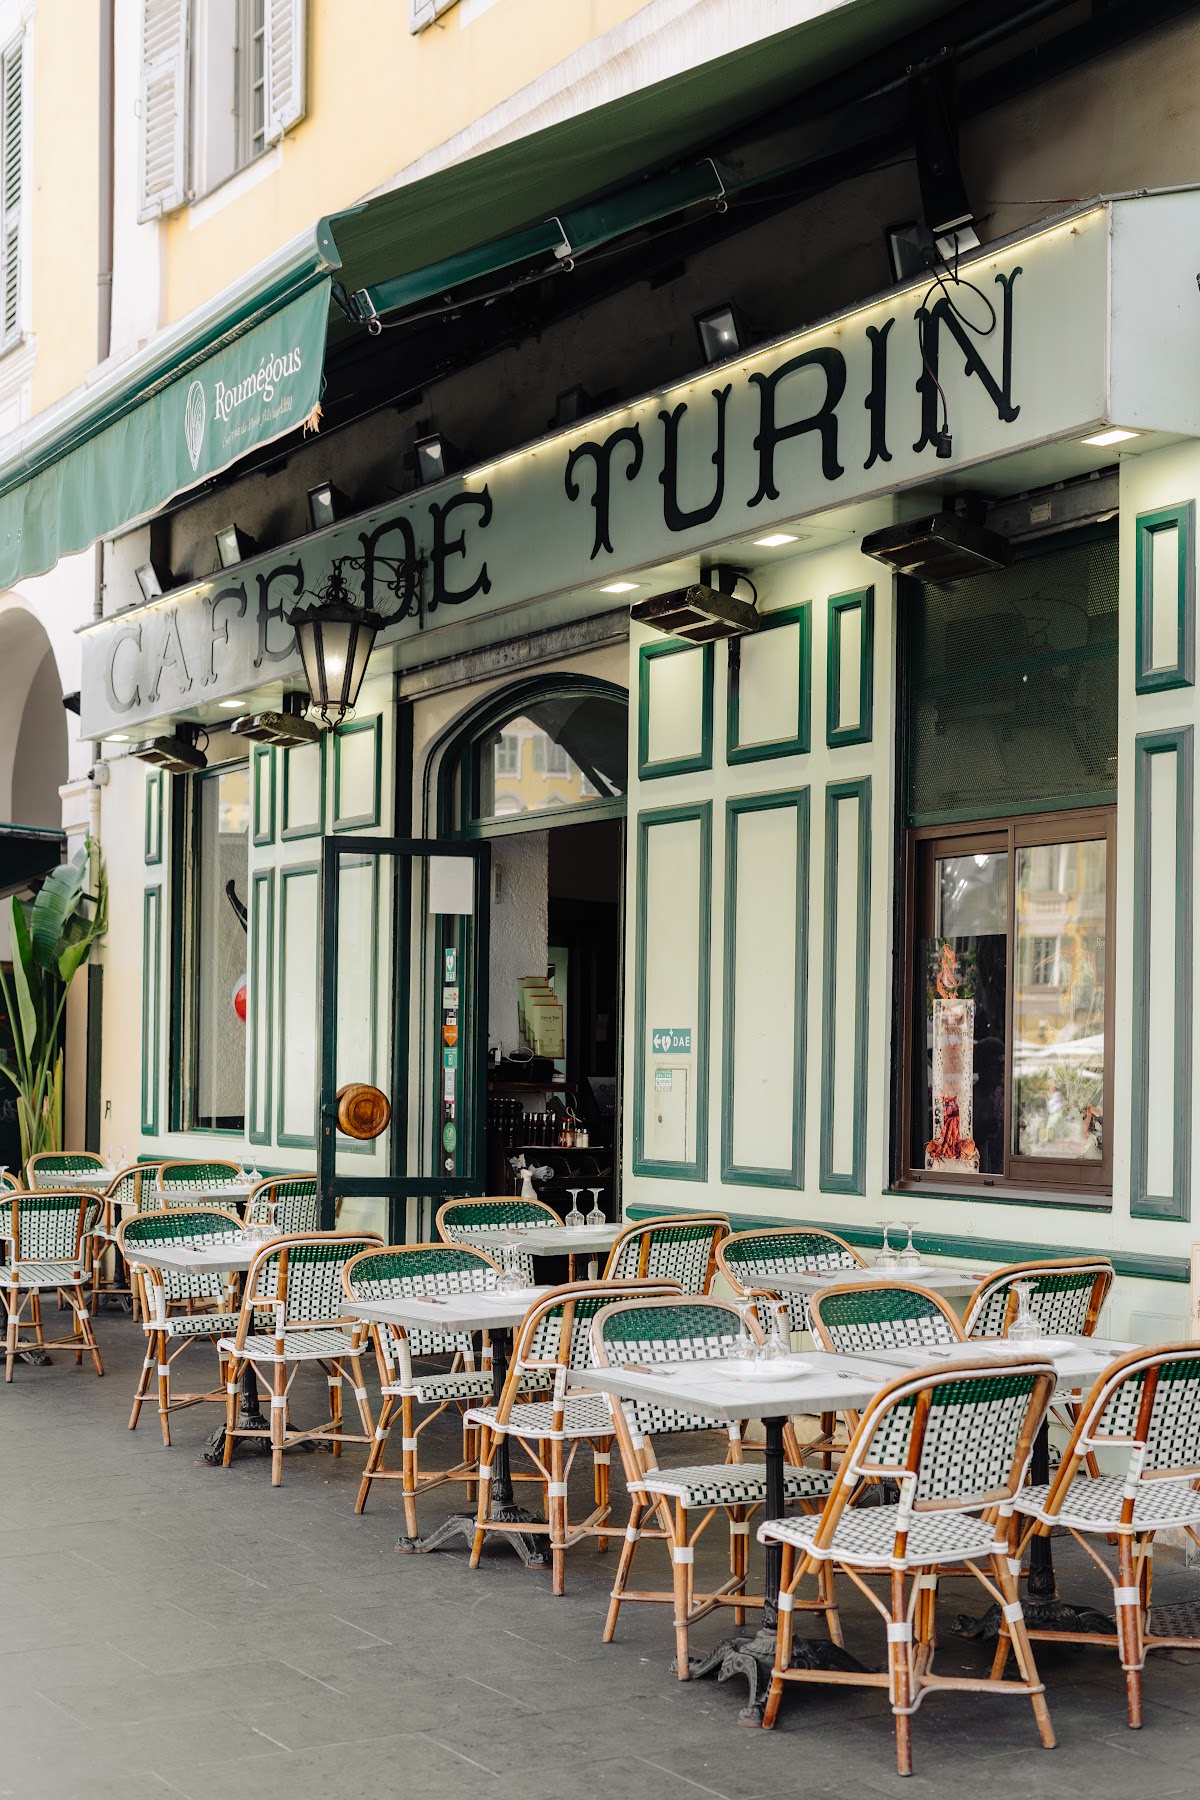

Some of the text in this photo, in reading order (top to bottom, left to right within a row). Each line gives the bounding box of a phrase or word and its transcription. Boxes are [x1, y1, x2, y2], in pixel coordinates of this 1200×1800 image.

[213, 347, 302, 422] Roumégous
[104, 266, 1024, 713] CAFE DE TURIN
[673, 1036, 690, 1047] DAE
